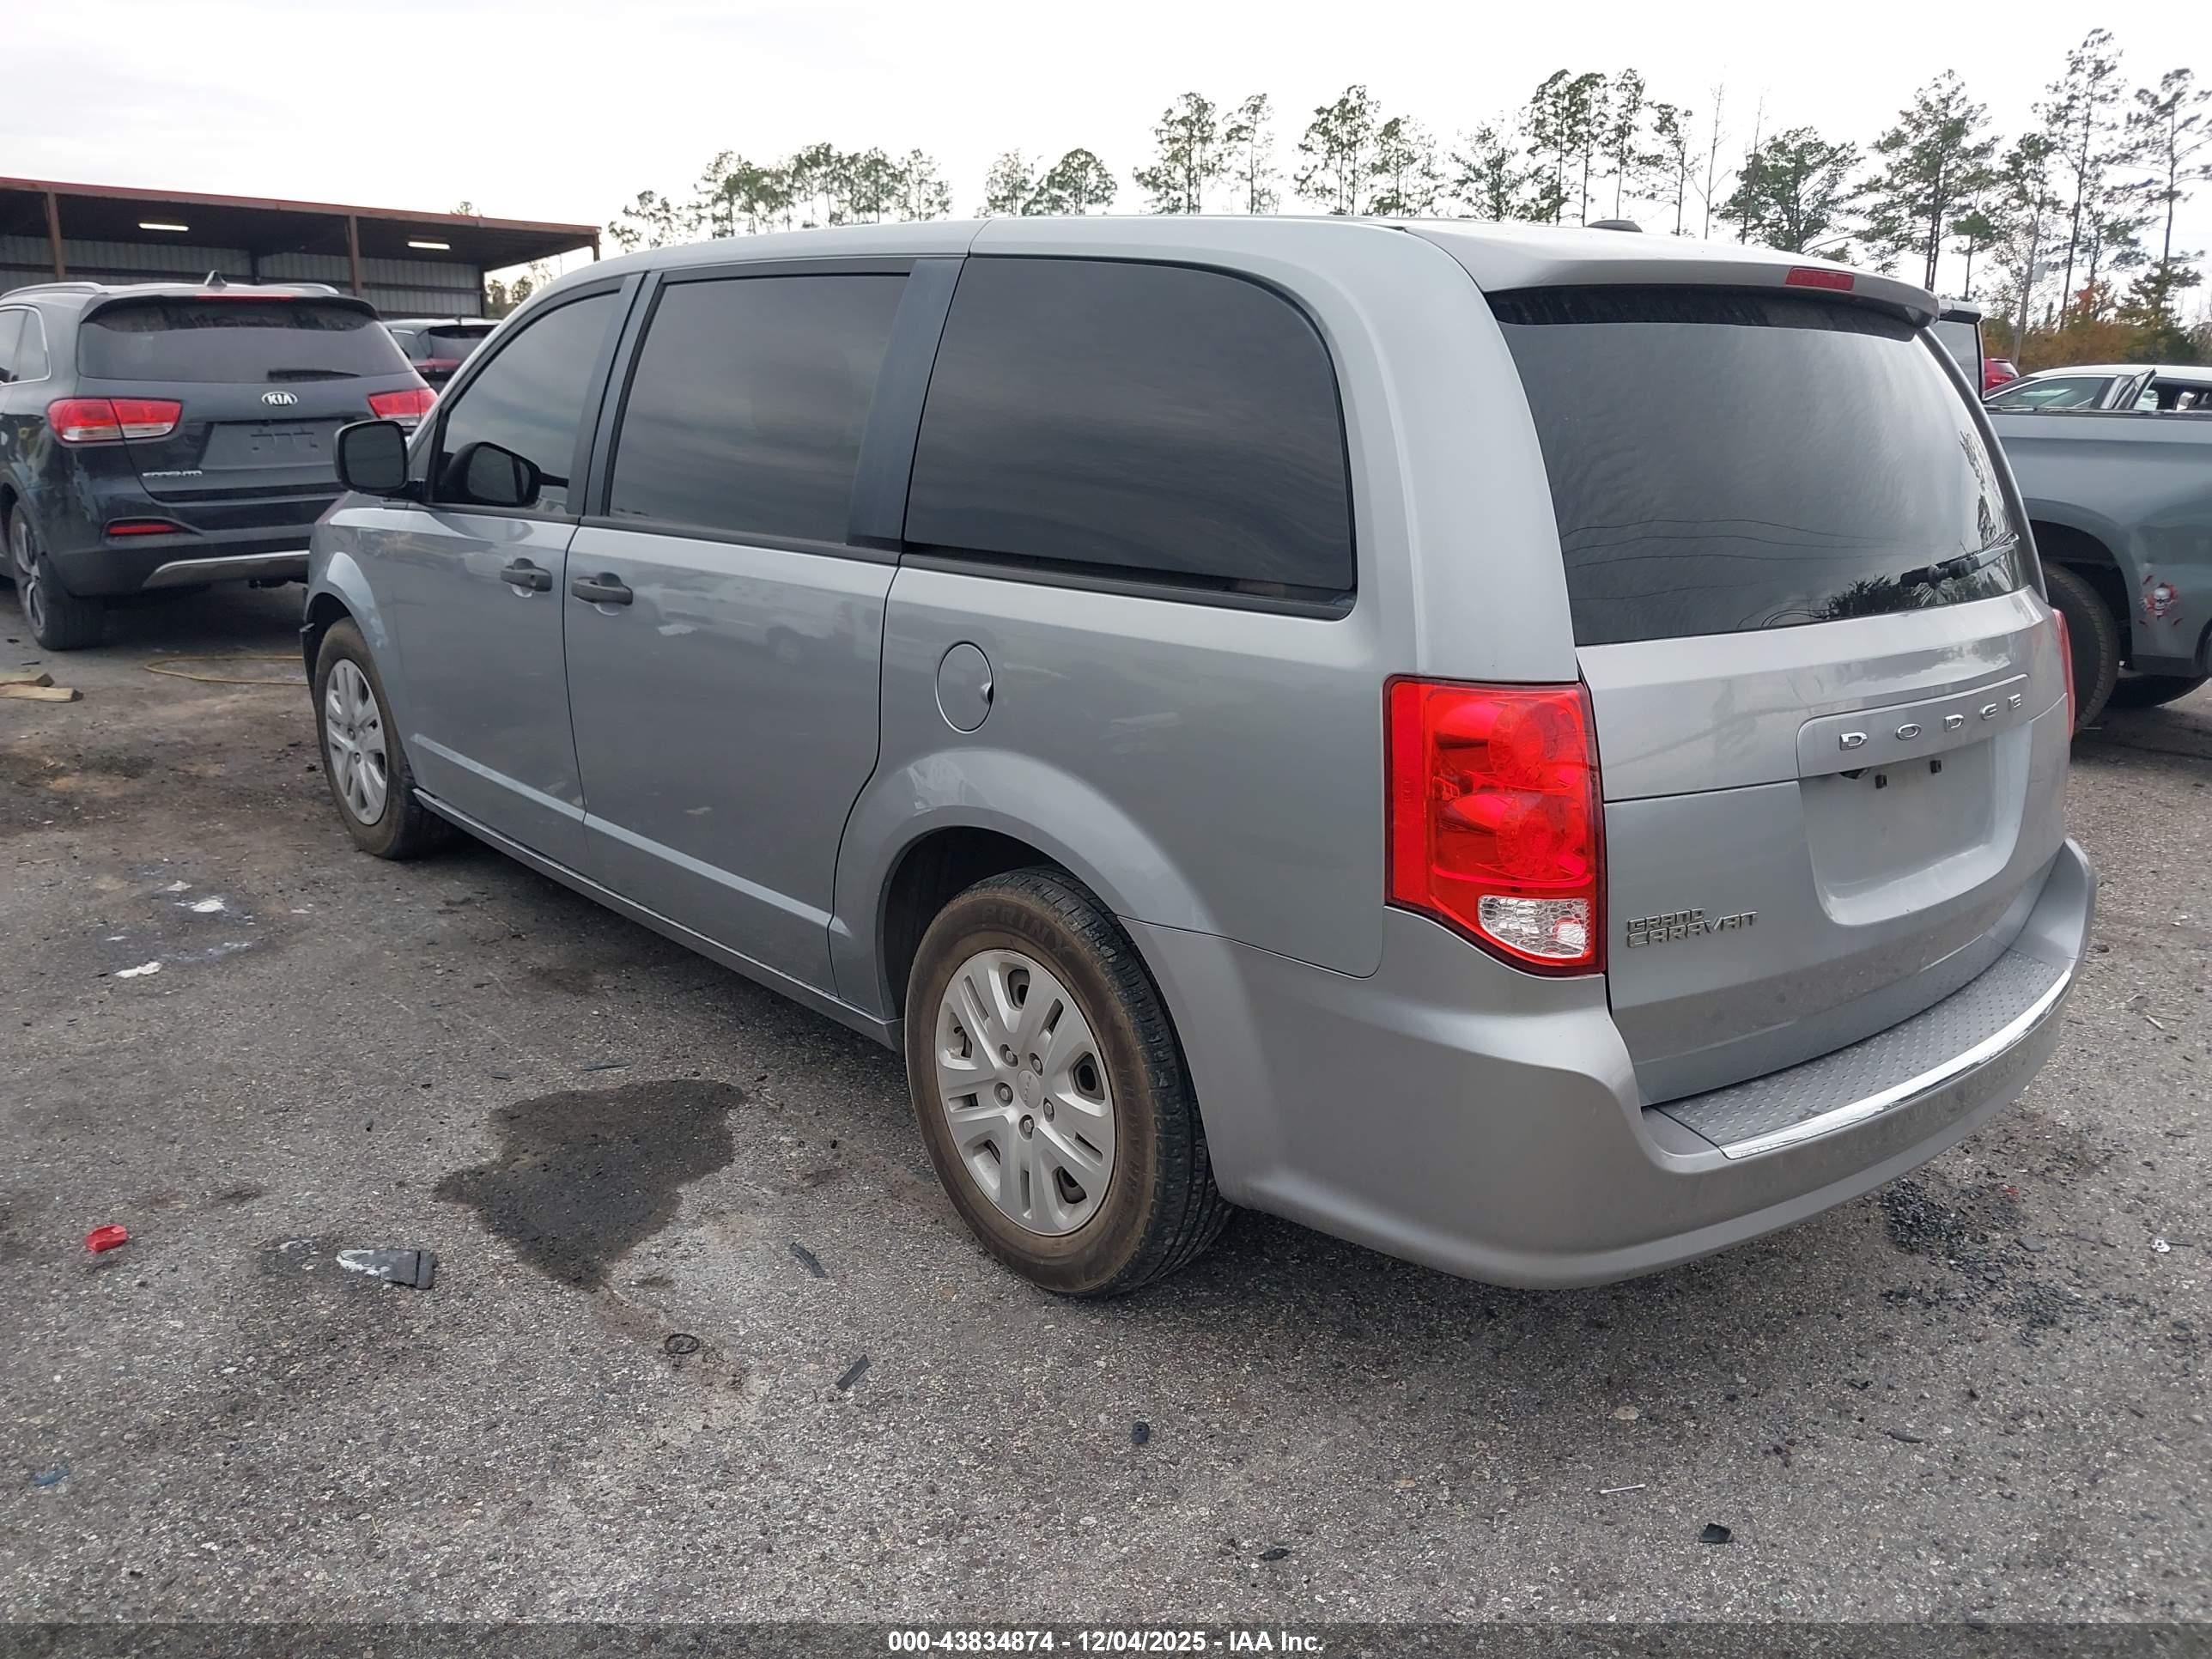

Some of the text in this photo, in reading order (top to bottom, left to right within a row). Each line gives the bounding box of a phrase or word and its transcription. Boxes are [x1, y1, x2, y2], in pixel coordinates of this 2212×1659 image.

[267, 393, 293, 405] KIA
[1838, 693, 2022, 751] DODGE
[1626, 911, 1759, 948] CARAVAN
[1627, 908, 1705, 933] GRAND
